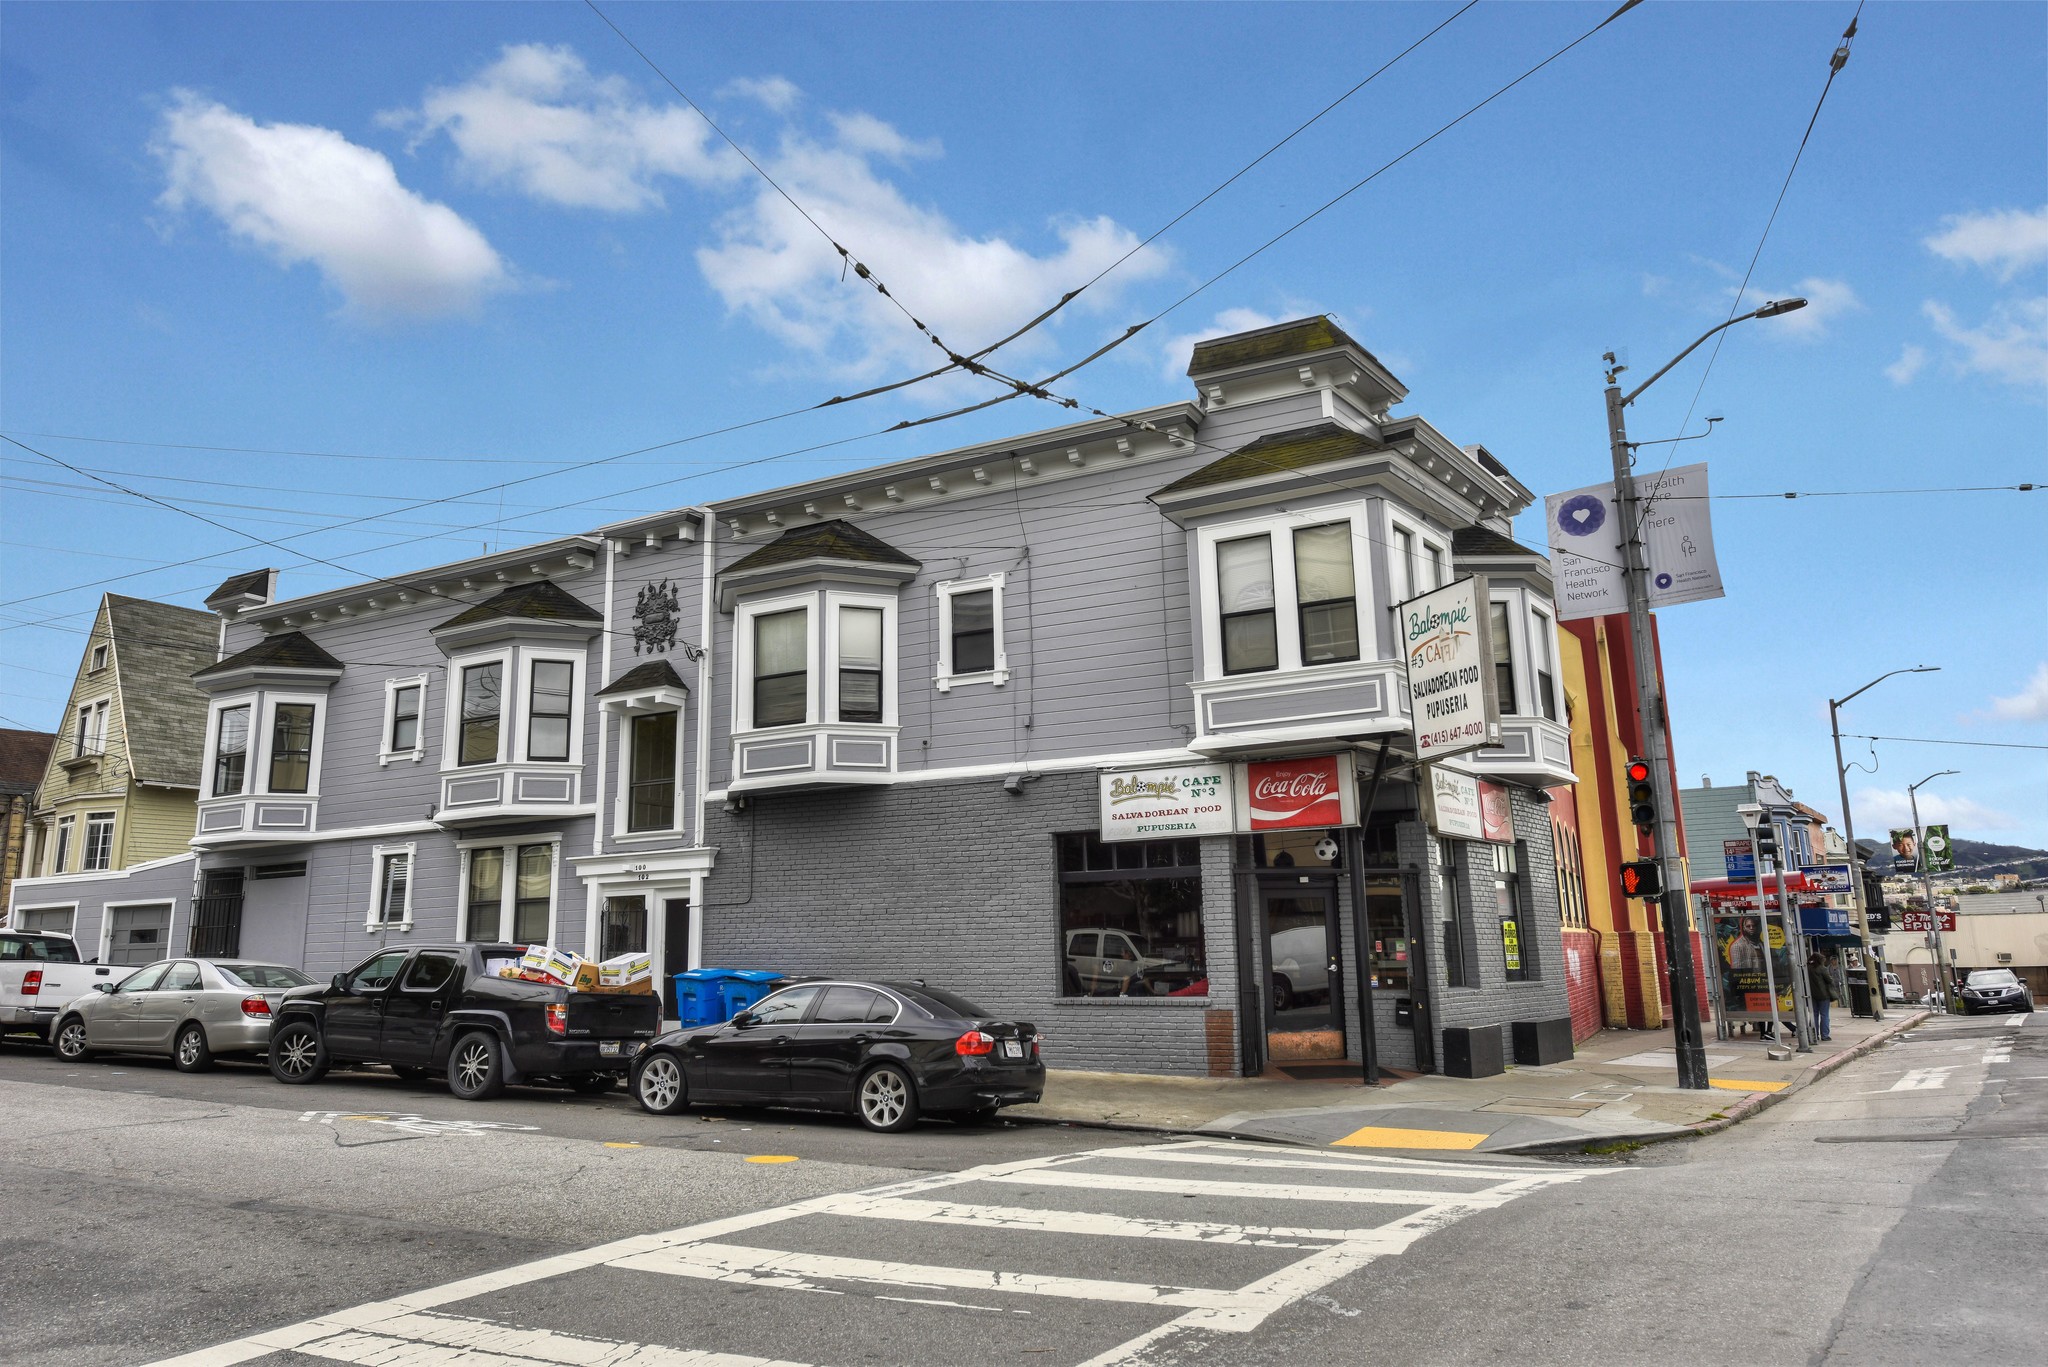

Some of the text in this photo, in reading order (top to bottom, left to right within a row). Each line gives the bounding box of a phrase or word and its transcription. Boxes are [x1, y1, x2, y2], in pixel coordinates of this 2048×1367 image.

[1644, 476, 1685, 492] Health
[1648, 516, 1675, 530] here
[1562, 556, 1582, 567] San
[1564, 564, 1611, 578] Francisco
[1565, 578, 1598, 590] Health
[1567, 588, 1609, 601] Network
[1411, 653, 1424, 669] #3
[1413, 665, 1479, 700] SALVADOREAN FOOD
[1426, 693, 1469, 720] PUPUSERIA
[1430, 721, 1483, 746] (415) 647-4000
[1182, 775, 1222, 787] CAFE
[1255, 772, 1329, 800] Coca-Cola
[1111, 805, 1222, 821] SALVADOREAN FOOD
[1137, 822, 1197, 832] PUPUSERIA
